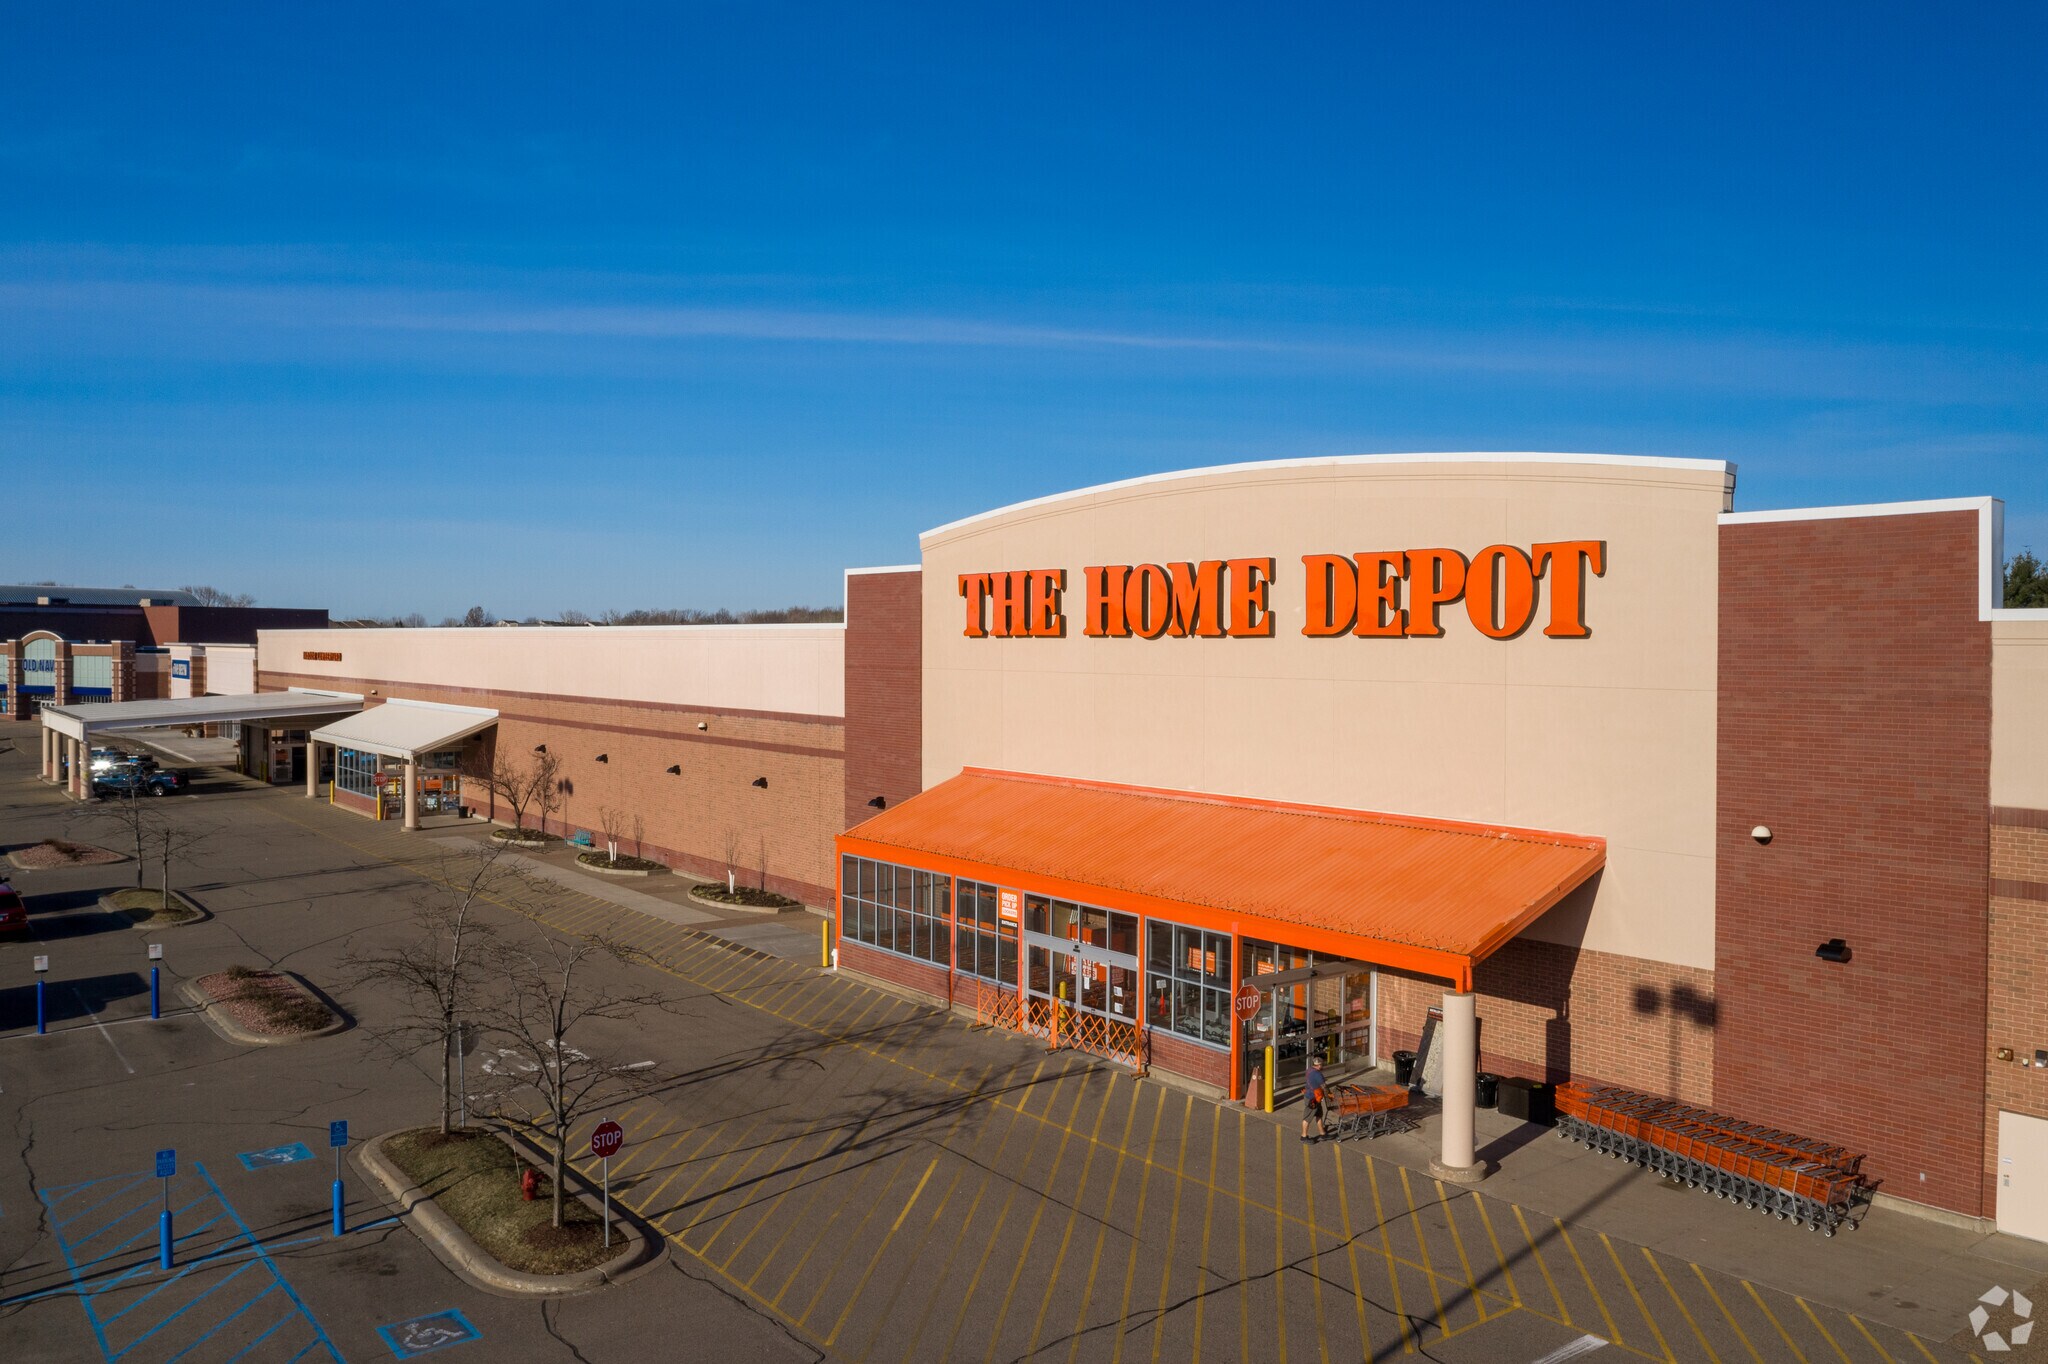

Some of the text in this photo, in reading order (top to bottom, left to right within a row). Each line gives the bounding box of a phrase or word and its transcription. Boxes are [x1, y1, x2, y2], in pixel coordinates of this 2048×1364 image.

[958, 540, 1607, 640] THE HOME DEPOT
[23, 658, 55, 672] OLD NAV
[1002, 892, 1017, 902] ORDER
[1236, 995, 1259, 1010] STOP
[593, 1130, 621, 1149] STOP
